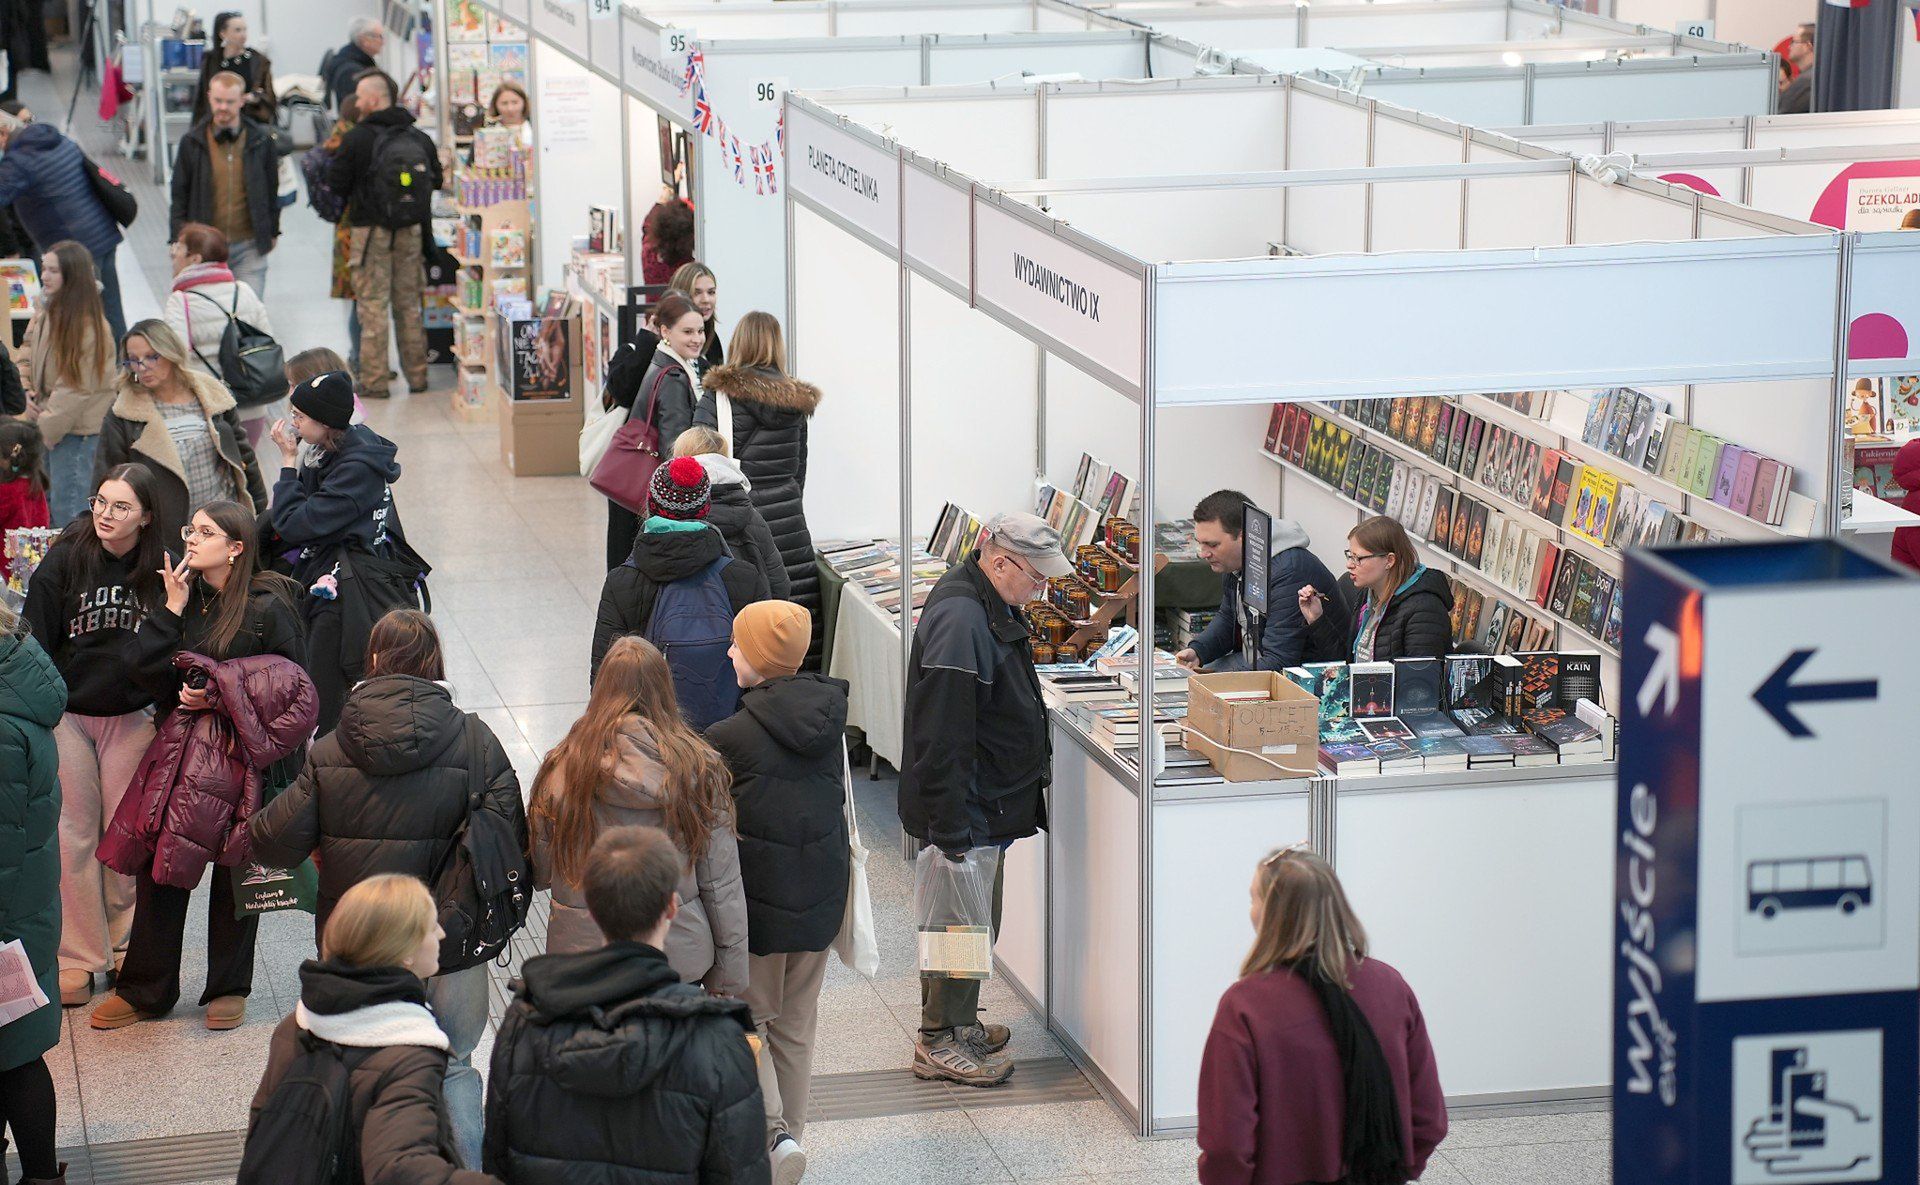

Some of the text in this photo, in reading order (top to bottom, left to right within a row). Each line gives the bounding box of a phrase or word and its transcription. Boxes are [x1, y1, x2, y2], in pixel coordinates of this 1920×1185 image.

[595, 0, 610, 13] 94
[670, 35, 686, 51] 95
[757, 82, 775, 101] 96
[808, 145, 879, 203] PLANETA CZYTELNIKA
[1858, 193, 1920, 206] CZEKOLAD
[1013, 252, 1100, 322] WYDAWNICTWO IX
[1566, 663, 1592, 671] KAIN
[1240, 706, 1314, 726] OUTLET
[1621, 783, 1662, 1094] wyjście
